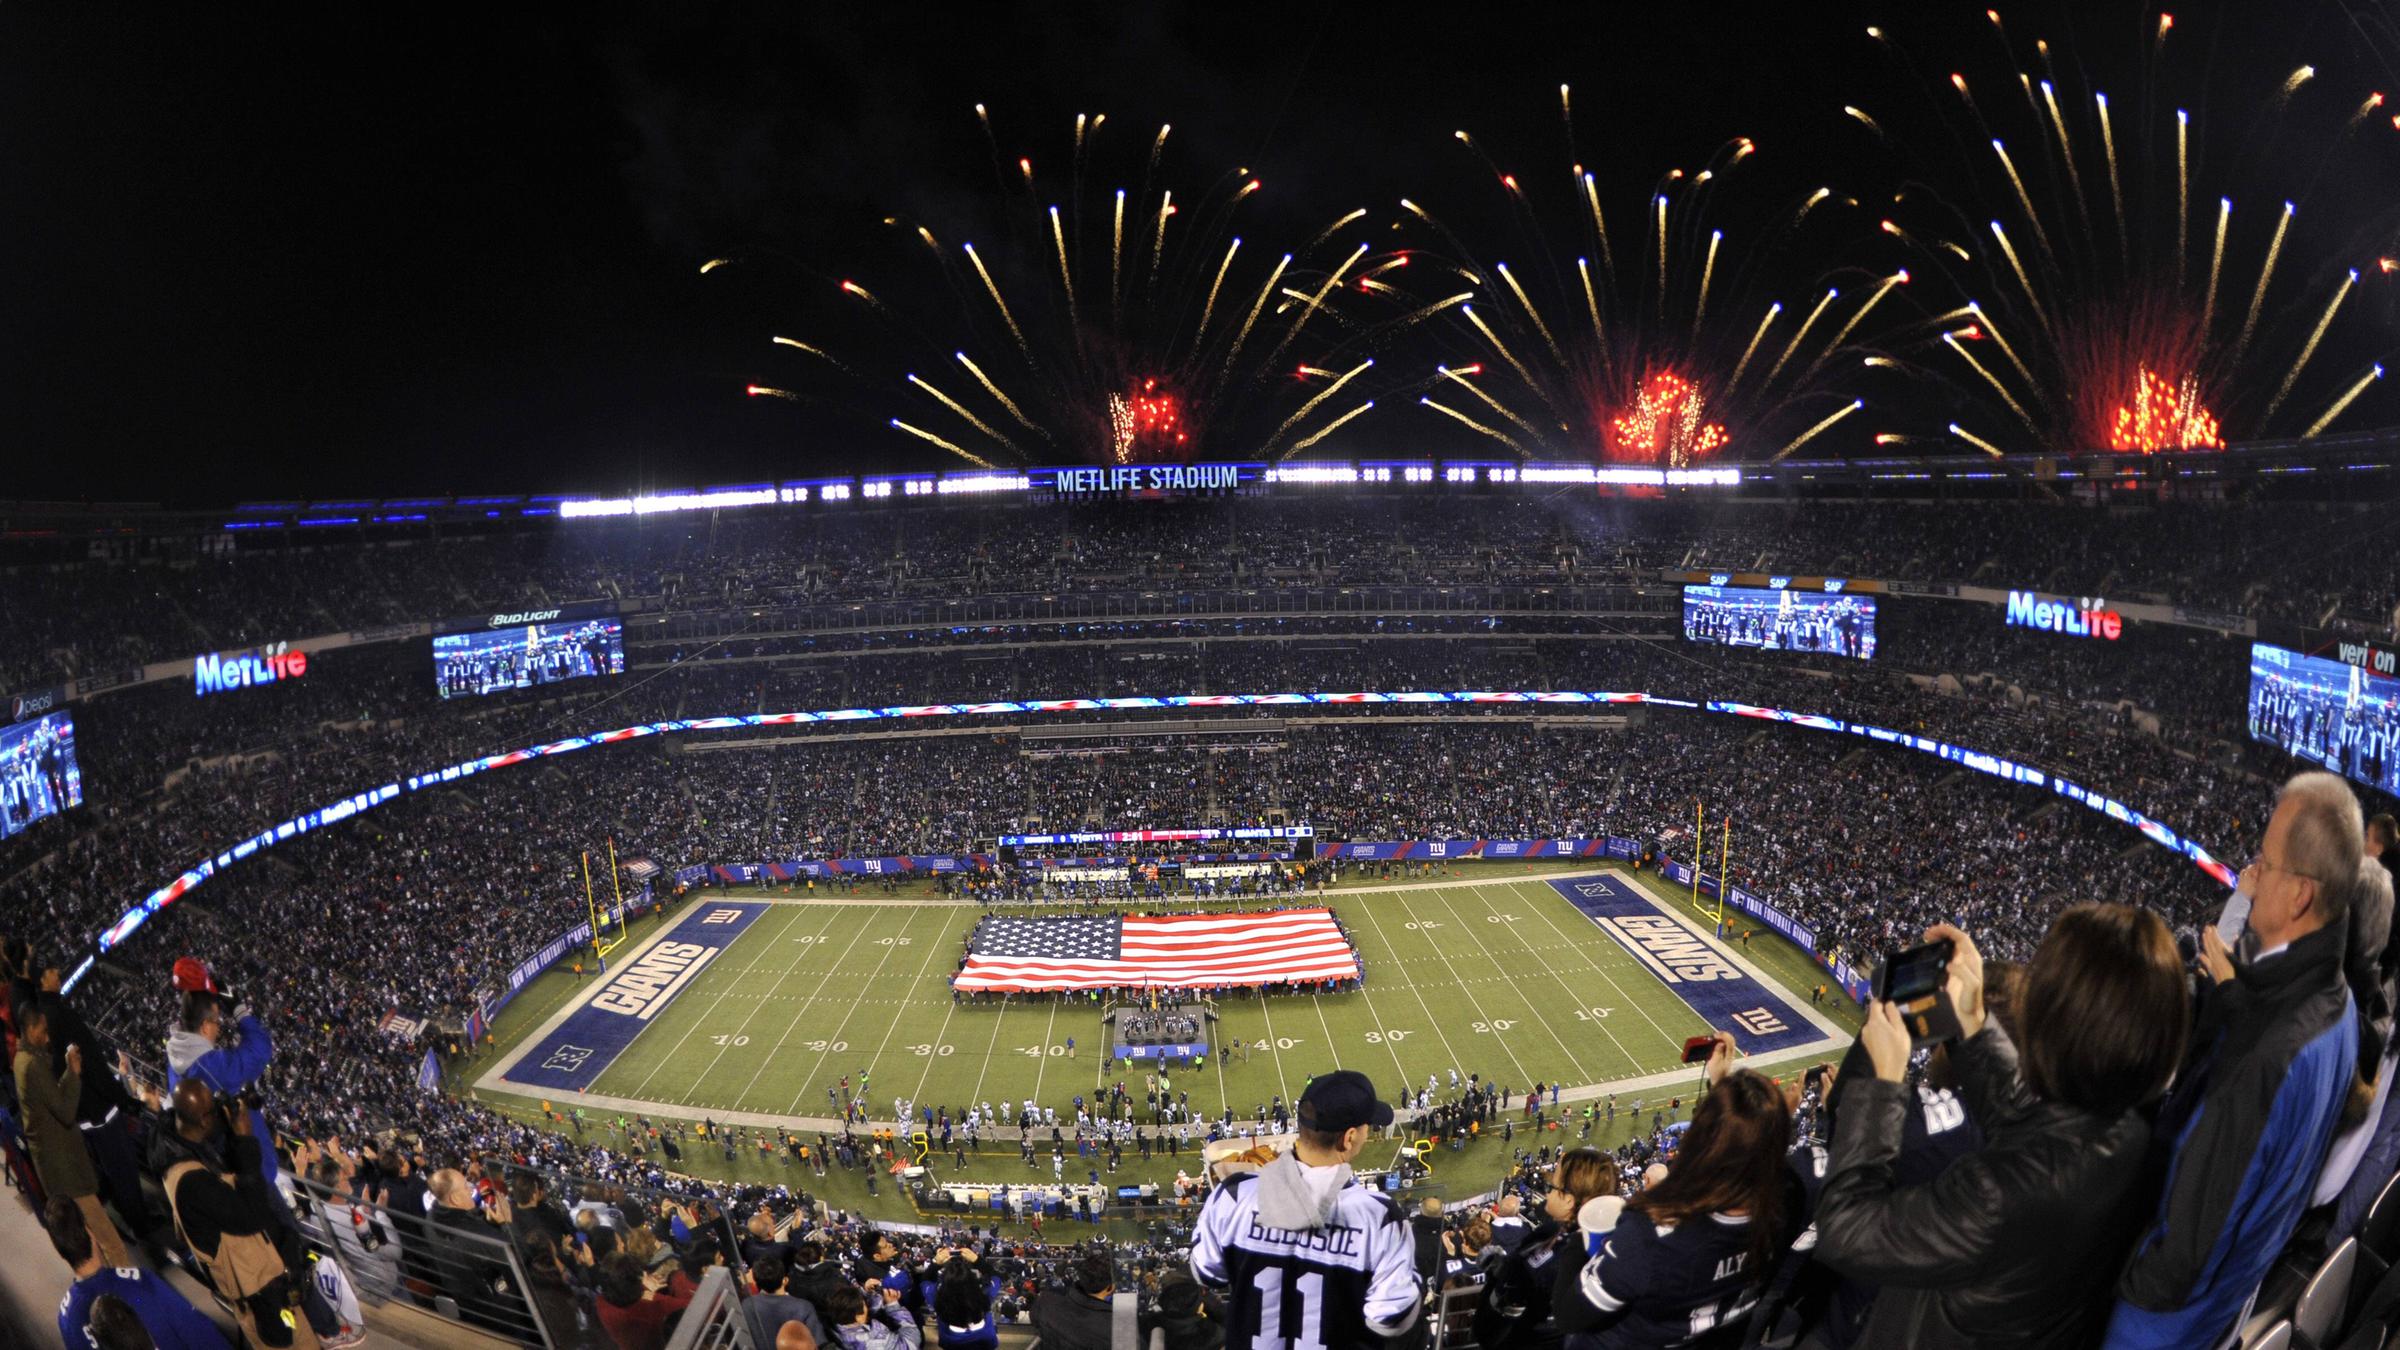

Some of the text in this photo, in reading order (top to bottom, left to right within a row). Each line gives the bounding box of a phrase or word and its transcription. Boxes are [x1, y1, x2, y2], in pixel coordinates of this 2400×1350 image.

[1057, 466, 1238, 492] METLIFE STADIUM
[1710, 575, 1728, 586] SAP
[1769, 578, 1787, 589] SAP
[1824, 581, 1842, 593] SAP
[2006, 590, 2122, 640] MetLife
[2339, 641, 2395, 677] verizon
[196, 641, 307, 696] MetLife
[25, 692, 52, 718] pepsi
[1352, 845, 1376, 857] GIANTS
[1429, 843, 1446, 856] ny
[864, 860, 881, 873] ny
[1763, 906, 1792, 934] FOOTBALL
[1613, 915, 1743, 982] GIANTS
[591, 940, 704, 1015] GIANTS
[1573, 1006, 1609, 1021] 10
[1731, 1006, 1790, 1036] ny
[1471, 1019, 1511, 1034] 20
[714, 1034, 750, 1047] 10
[1253, 1037, 1294, 1050] 40
[1364, 1029, 1405, 1044] 30
[809, 1040, 849, 1052] 20
[914, 1044, 955, 1056] 30
[1025, 1045, 1065, 1057] 40
[1132, 1047, 1146, 1056] ny
[1251, 1266, 1327, 1350] 11
